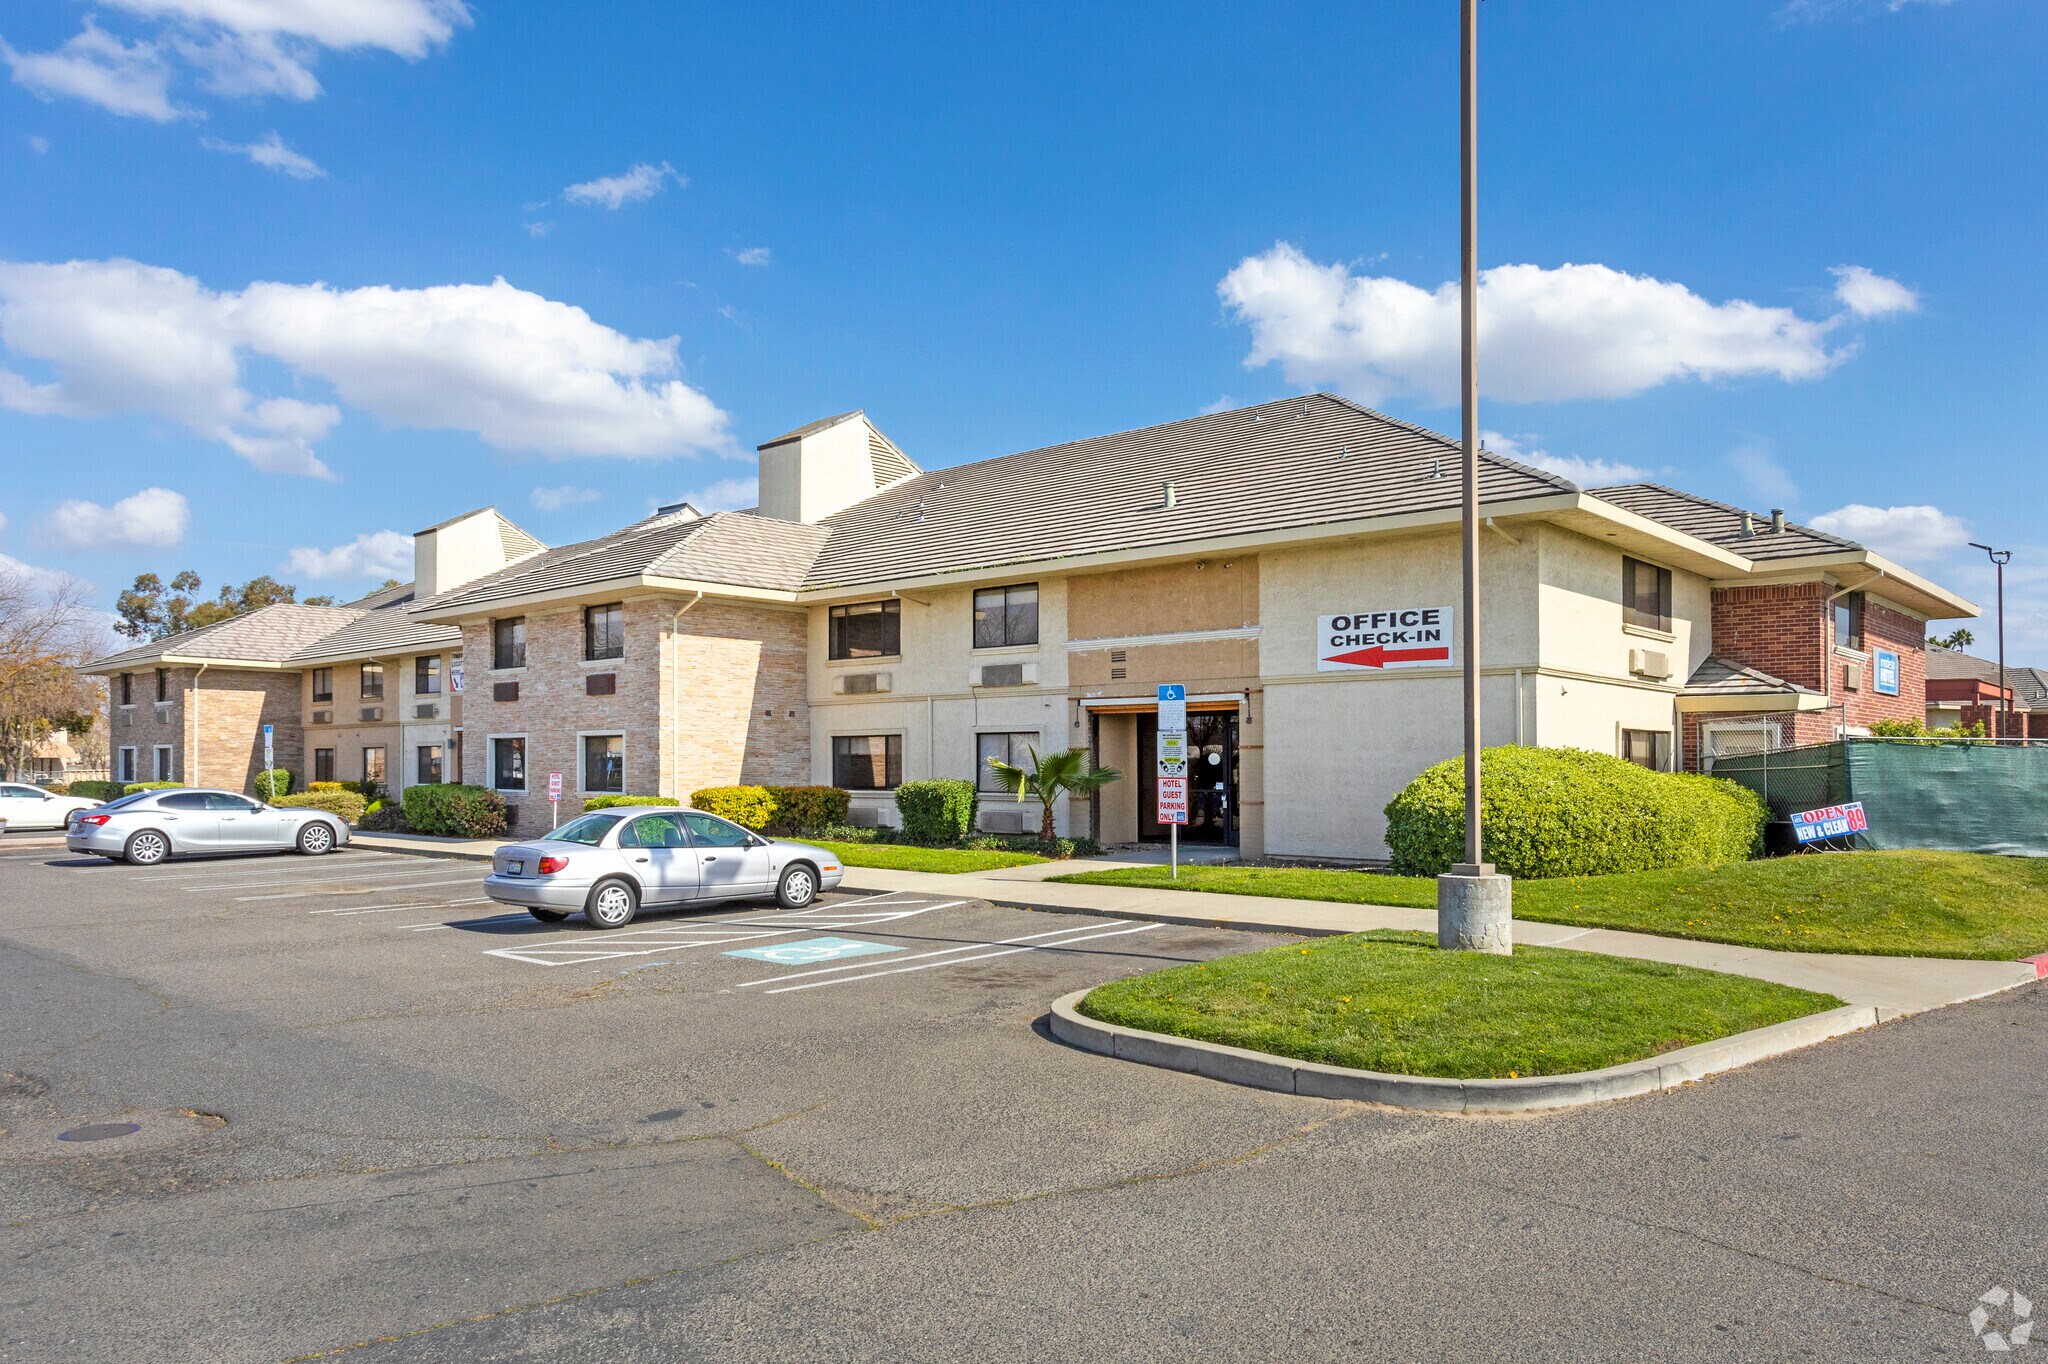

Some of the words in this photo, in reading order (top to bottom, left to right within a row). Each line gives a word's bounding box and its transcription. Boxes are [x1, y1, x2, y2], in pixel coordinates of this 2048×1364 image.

[1331, 609, 1440, 631] OFFICE
[1330, 629, 1441, 647] CHECK-IN
[1162, 780, 1182, 788] HOTEL
[1162, 790, 1182, 799] GUEST
[1160, 802, 1185, 810] PARKING
[1804, 806, 1845, 823] OPEN
[1847, 808, 1866, 831] 89
[1796, 826, 1816, 840] NEW
[1816, 825, 1825, 838] &
[1824, 819, 1849, 836] CLEAN
